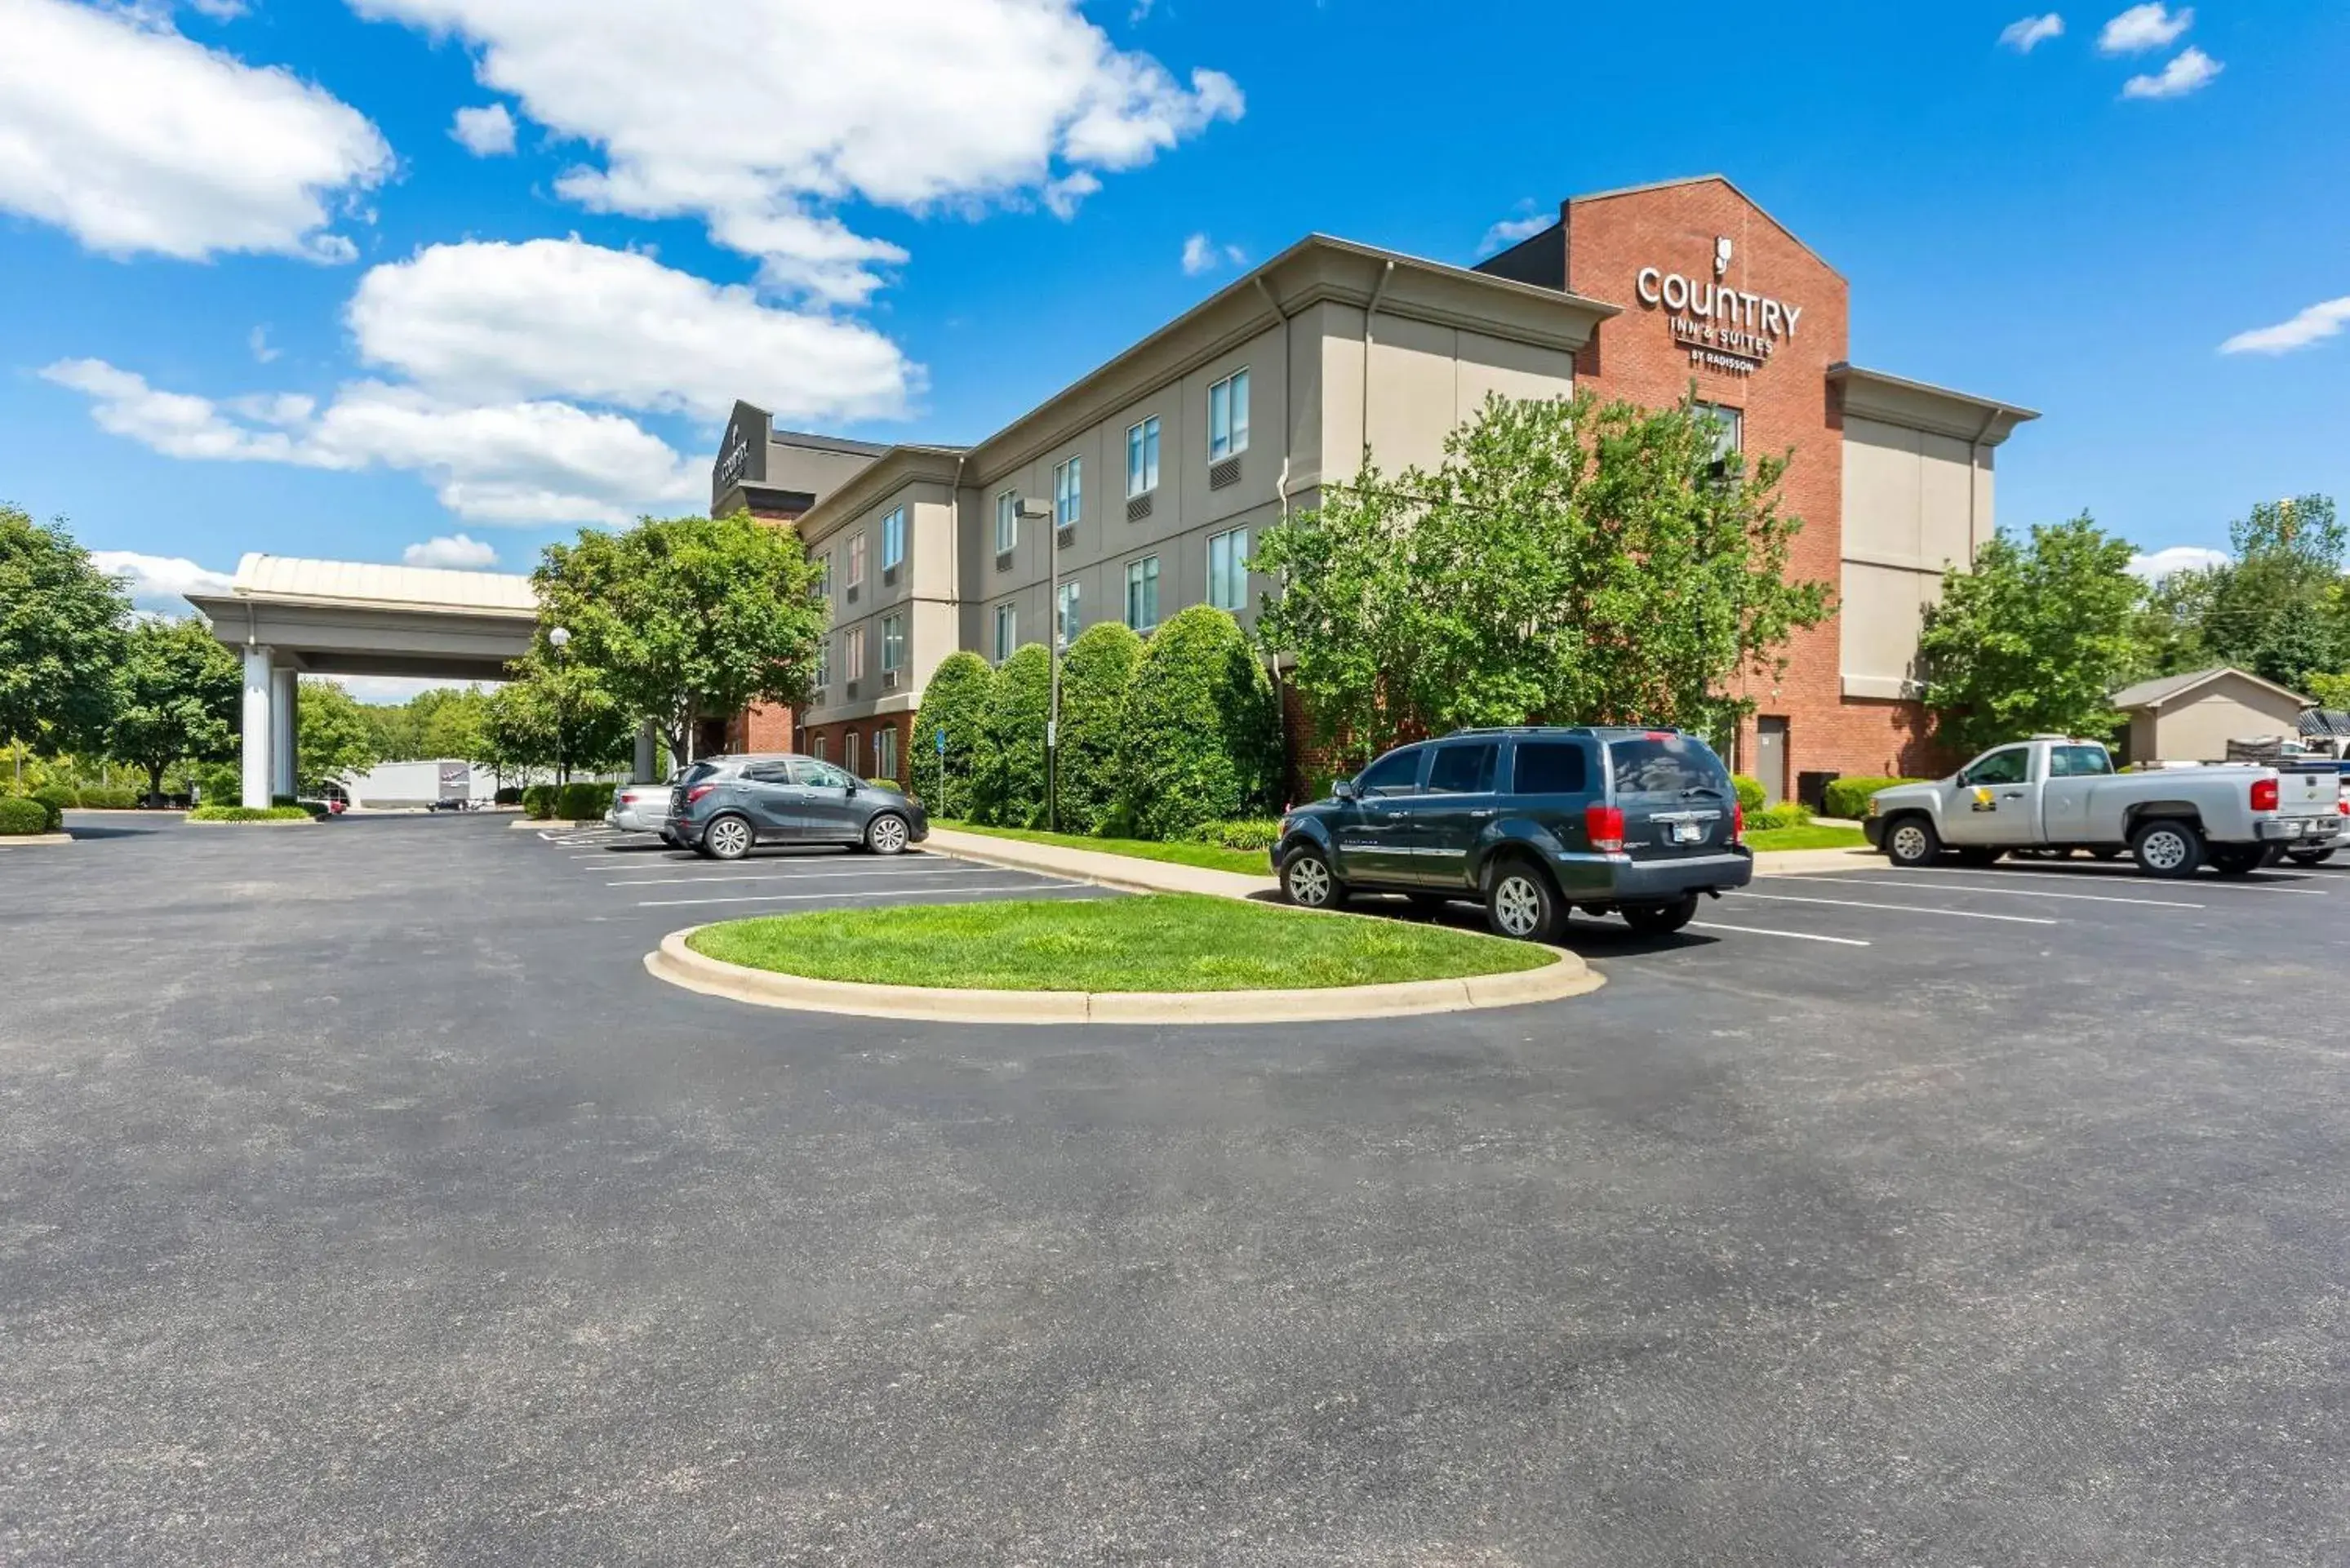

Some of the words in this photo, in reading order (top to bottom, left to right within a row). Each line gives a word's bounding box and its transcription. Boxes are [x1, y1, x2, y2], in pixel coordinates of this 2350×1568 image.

[1670, 316, 1698, 335] INN
[1704, 325, 1714, 340] &
[1720, 329, 1773, 354] SUITES
[1691, 349, 1704, 360] BY
[1707, 353, 1754, 371] RADISSON
